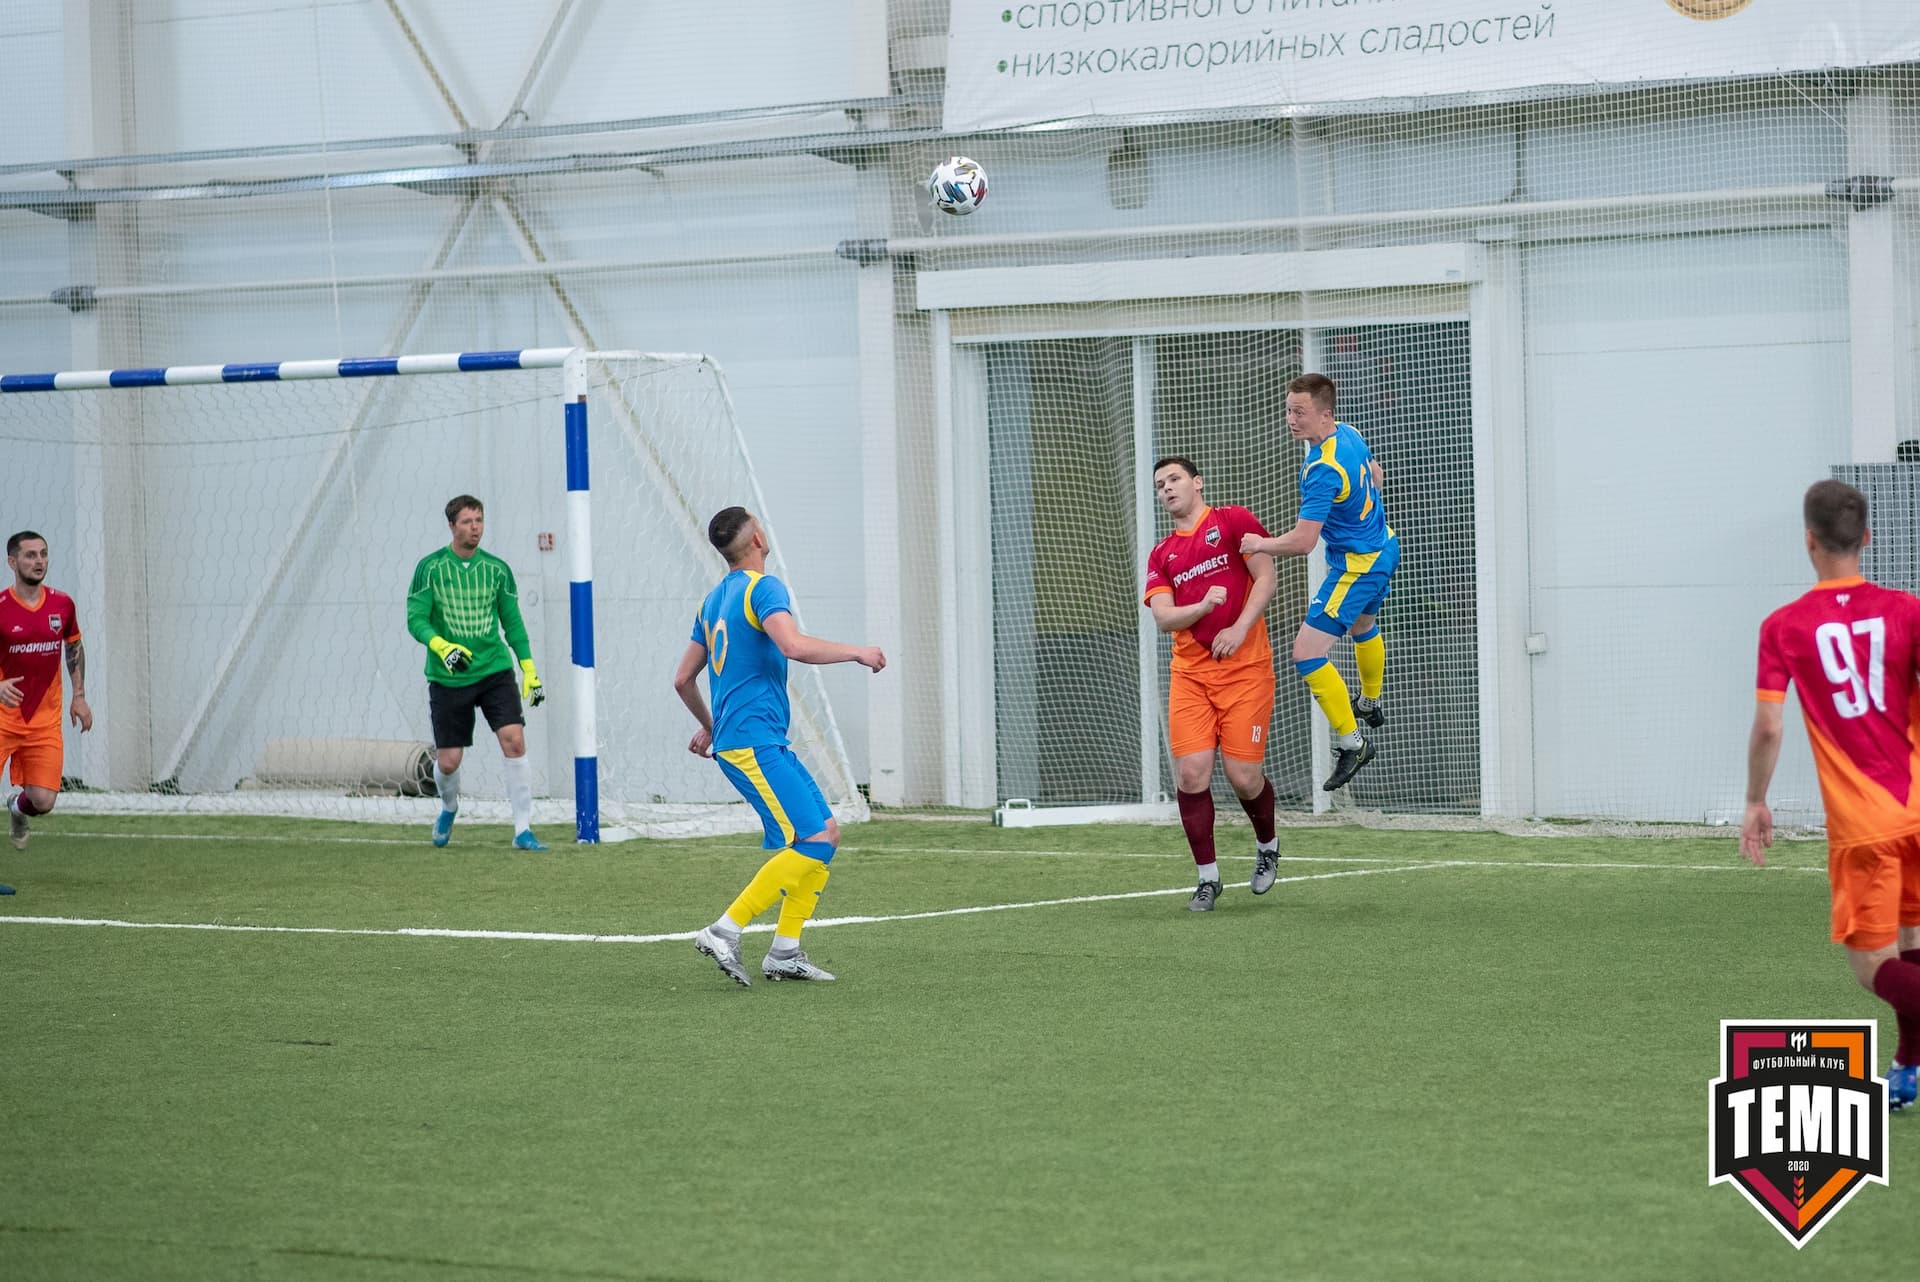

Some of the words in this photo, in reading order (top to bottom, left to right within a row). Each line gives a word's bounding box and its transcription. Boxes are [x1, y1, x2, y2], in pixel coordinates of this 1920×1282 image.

[1012, 29, 1348, 78] низкокалорийных
[1360, 3, 1556, 55] сладостей
[1815, 617, 1887, 719] 97
[1252, 725, 1261, 743] 13
